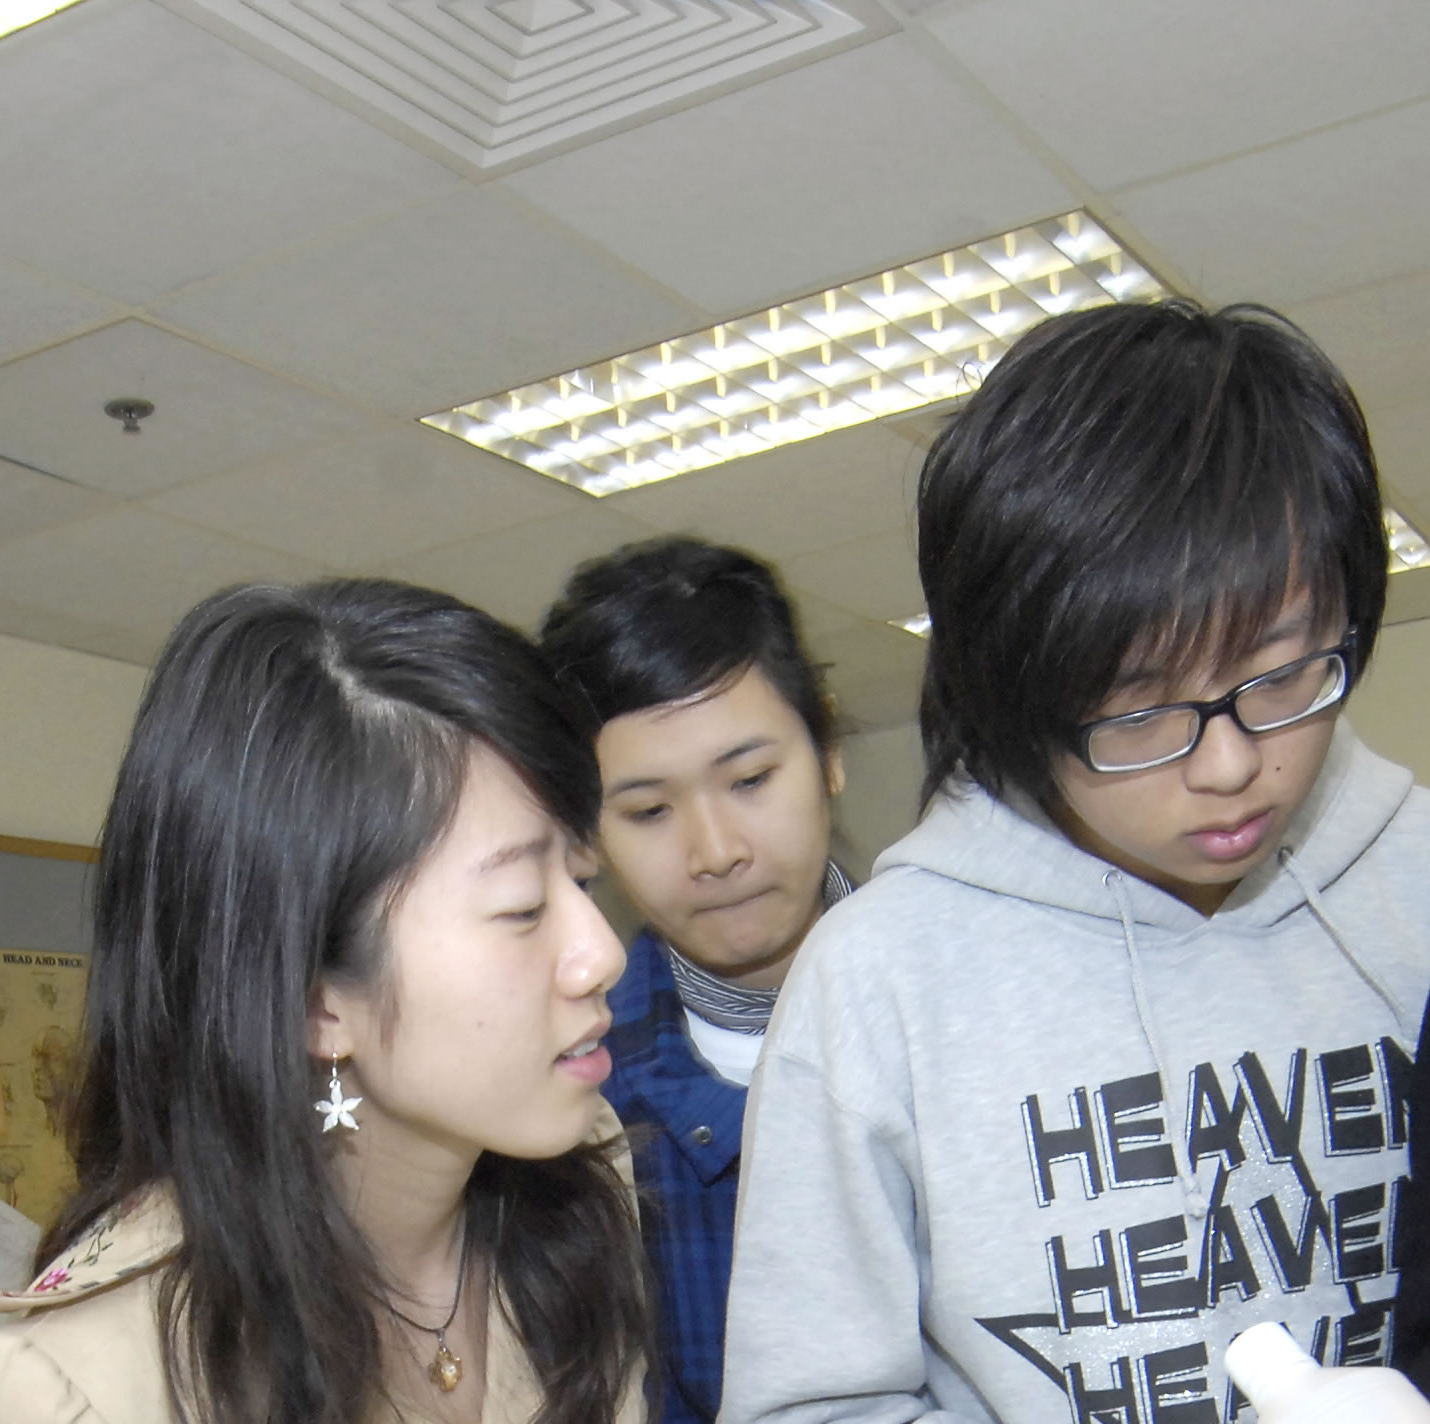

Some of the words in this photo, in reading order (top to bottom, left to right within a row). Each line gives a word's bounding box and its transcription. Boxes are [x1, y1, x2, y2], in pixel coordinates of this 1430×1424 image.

[3, 953, 32, 965] HEAD
[34, 955, 56, 966] AND
[1046, 1176, 1399, 1334] HEAVE
